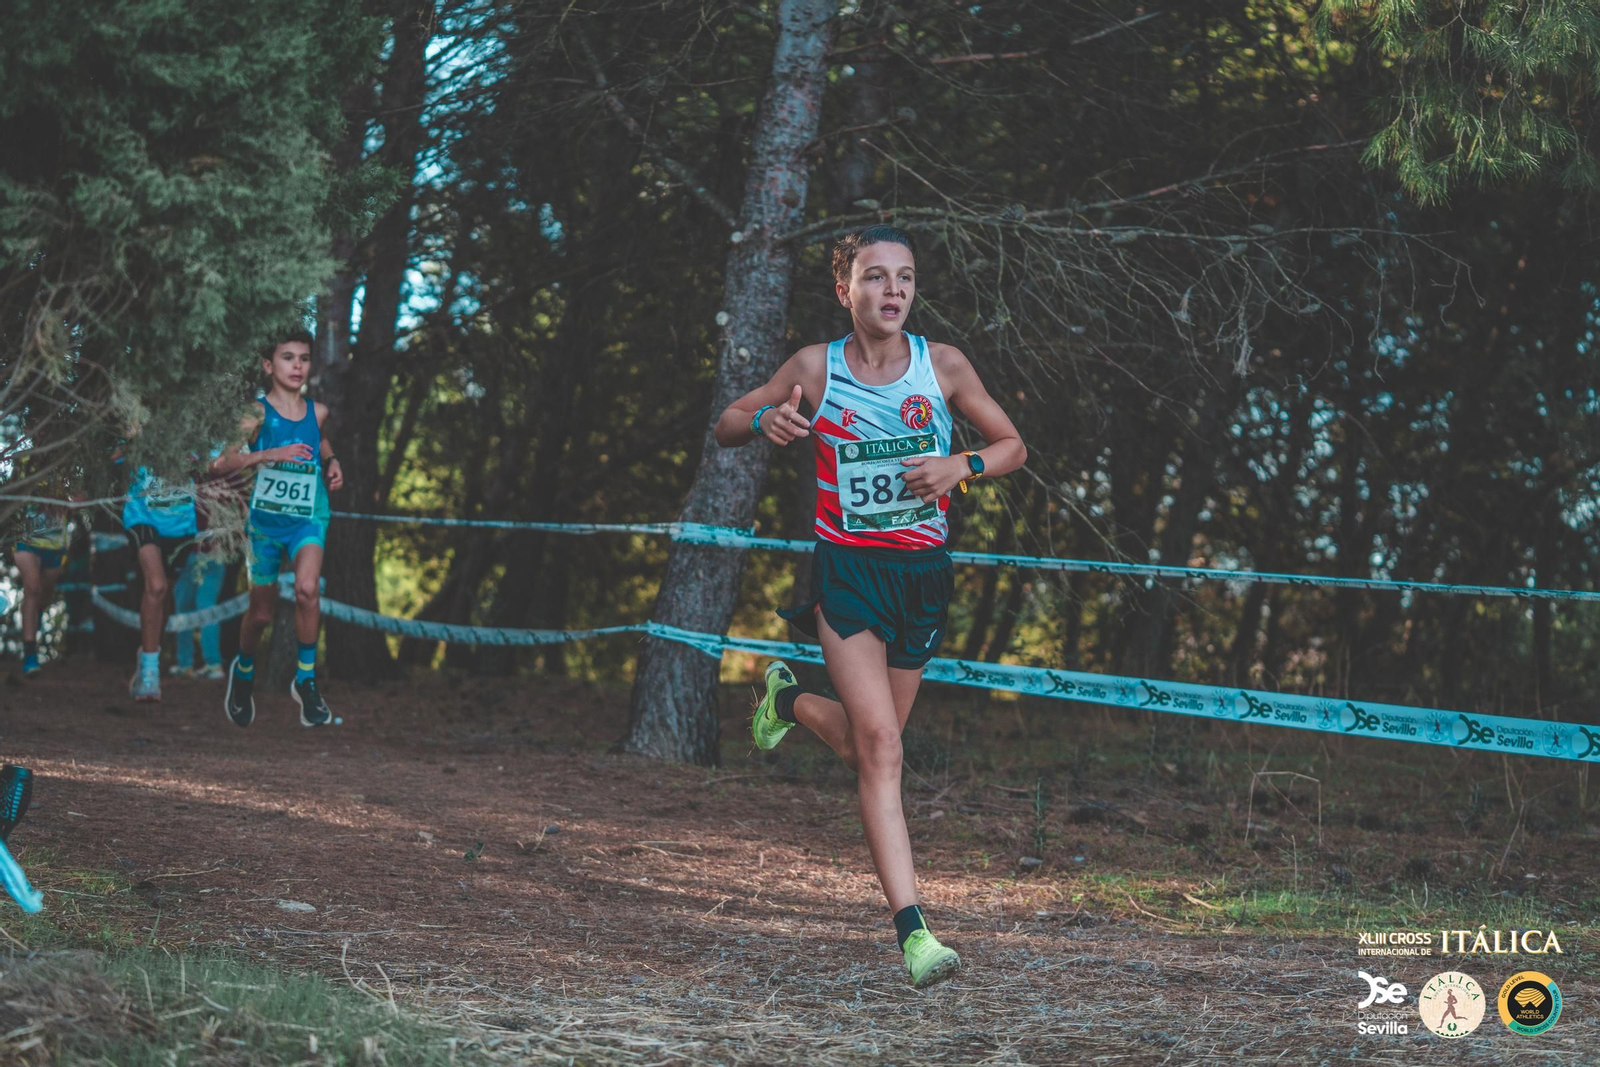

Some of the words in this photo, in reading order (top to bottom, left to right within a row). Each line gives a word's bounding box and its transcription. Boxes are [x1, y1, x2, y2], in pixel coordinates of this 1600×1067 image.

[866, 440, 914, 454] ITÁLICA
[263, 476, 311, 501] 7961
[850, 471, 916, 507] 582
[1173, 697, 1204, 711] Sevilla
[1274, 709, 1307, 723] Sevilla
[1382, 721, 1417, 736] Sevilla
[1496, 725, 1534, 736] Diputación
[1497, 734, 1534, 749] Sevilla
